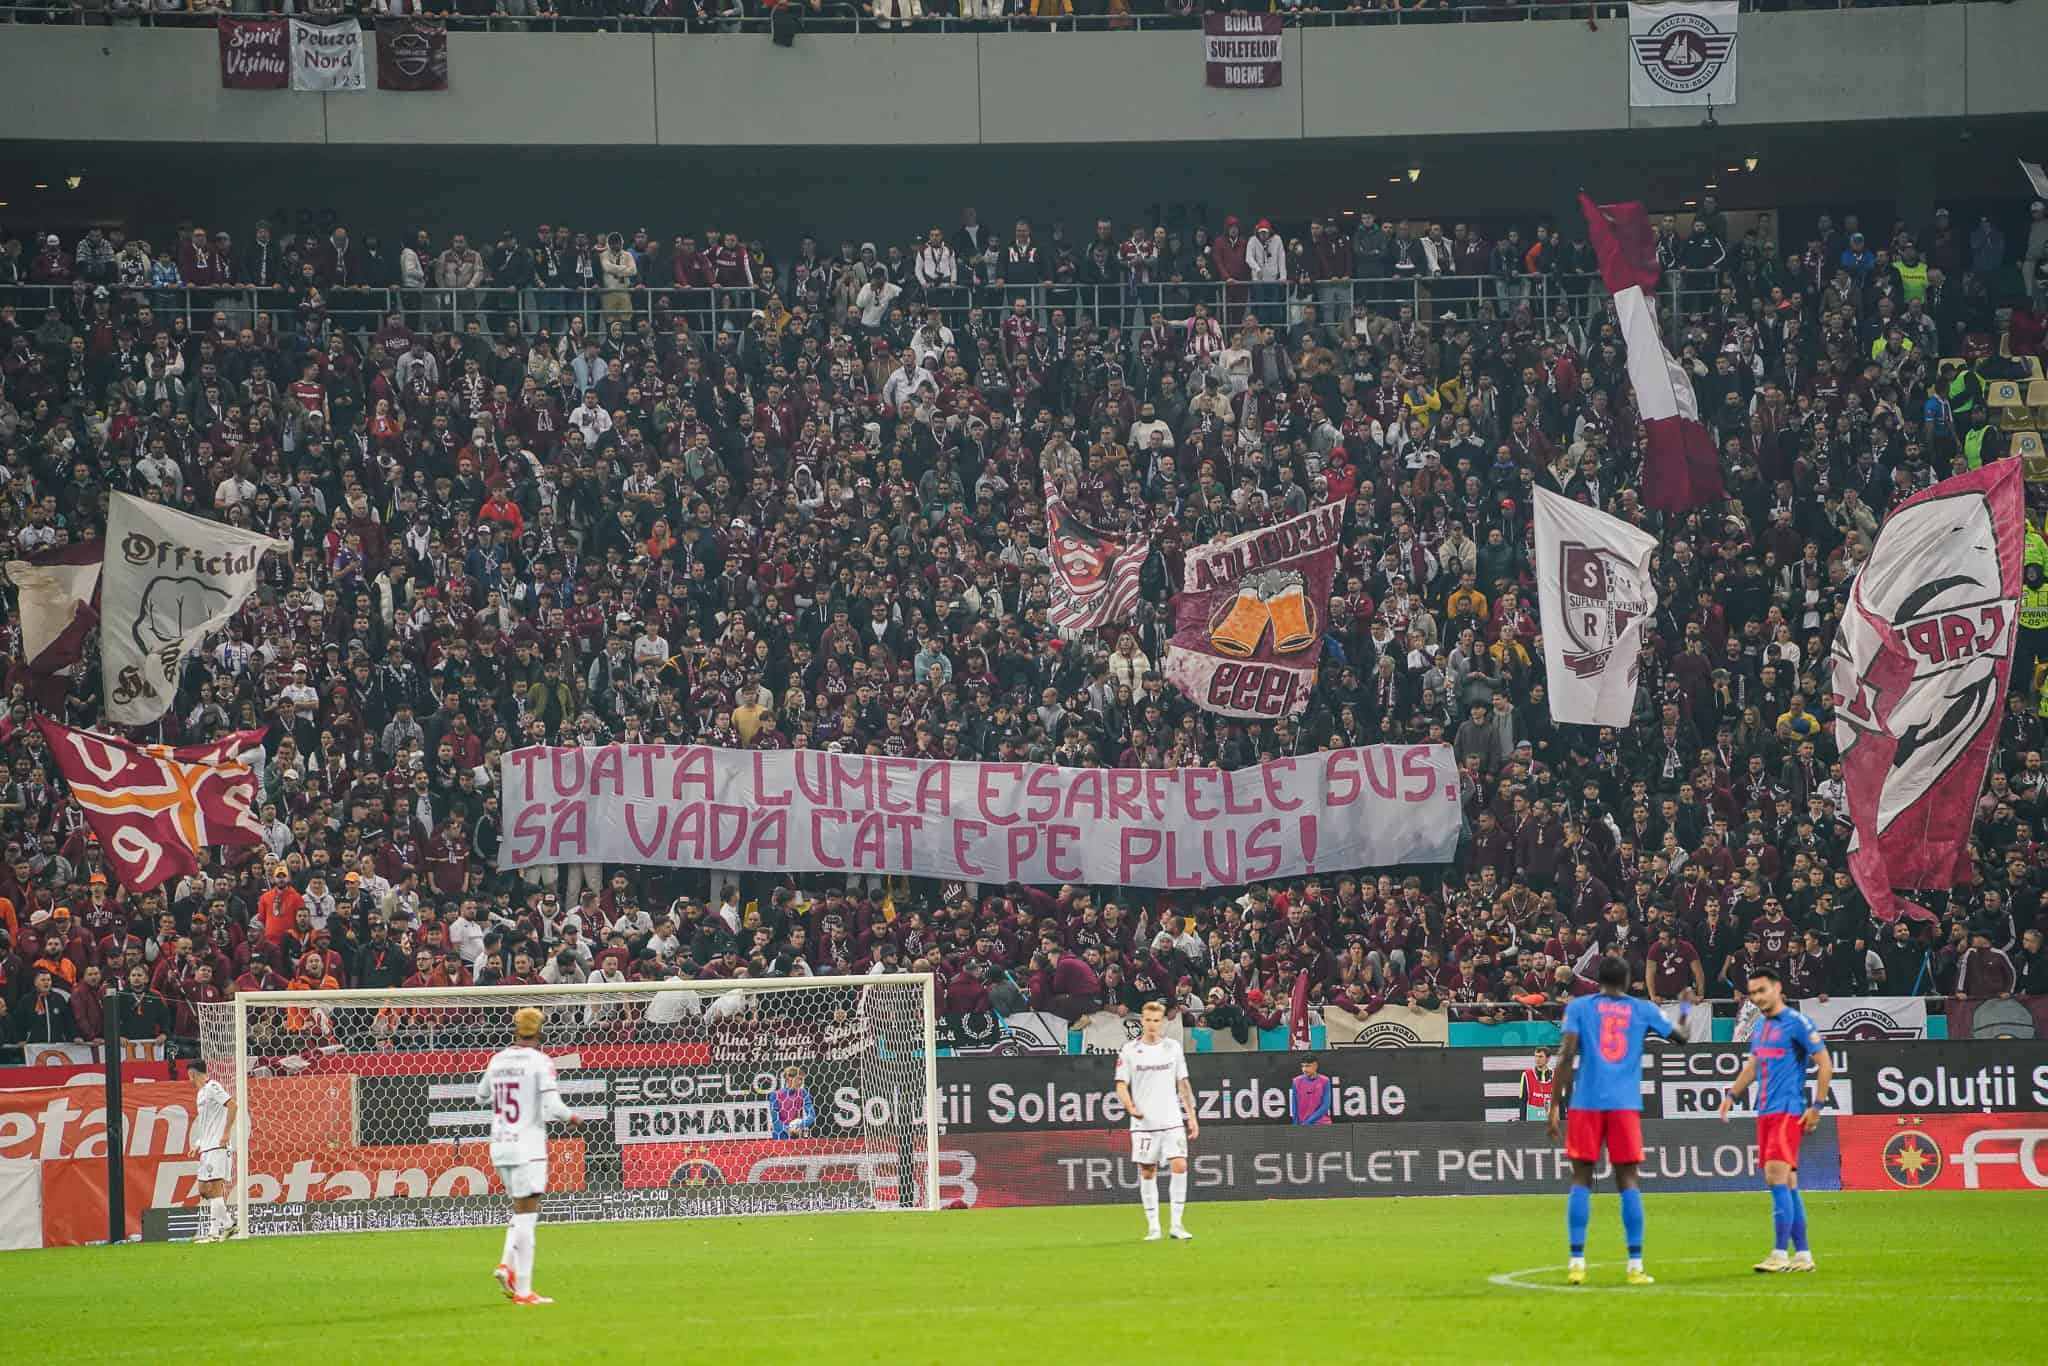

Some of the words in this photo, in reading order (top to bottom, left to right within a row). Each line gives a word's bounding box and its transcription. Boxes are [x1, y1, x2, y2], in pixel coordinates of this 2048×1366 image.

[230, 25, 281, 49] Spirit
[298, 27, 358, 47] Peluza
[1688, 17, 1711, 33] NORD
[303, 50, 352, 69] Nord
[1224, 66, 1264, 84] BOEME
[121, 531, 257, 577] Official
[1583, 561, 1599, 588] S
[1583, 612, 1598, 637] R
[1838, 1011, 1869, 1028] PELUZA
[1360, 1025, 1391, 1041] PELUZA
[1392, 1025, 1415, 1041] NORD
[1599, 1015, 1632, 1063] 5
[615, 1072, 785, 1101] ECOFLO
[1877, 1065, 2016, 1113] Soluții
[988, 1081, 1128, 1124] Solare
[628, 1108, 769, 1138] ROMANI
[1140, 1138, 1153, 1151] 17
[1254, 1150, 1421, 1185] SUFLET
[1637, 1144, 1761, 1178] CULOR
